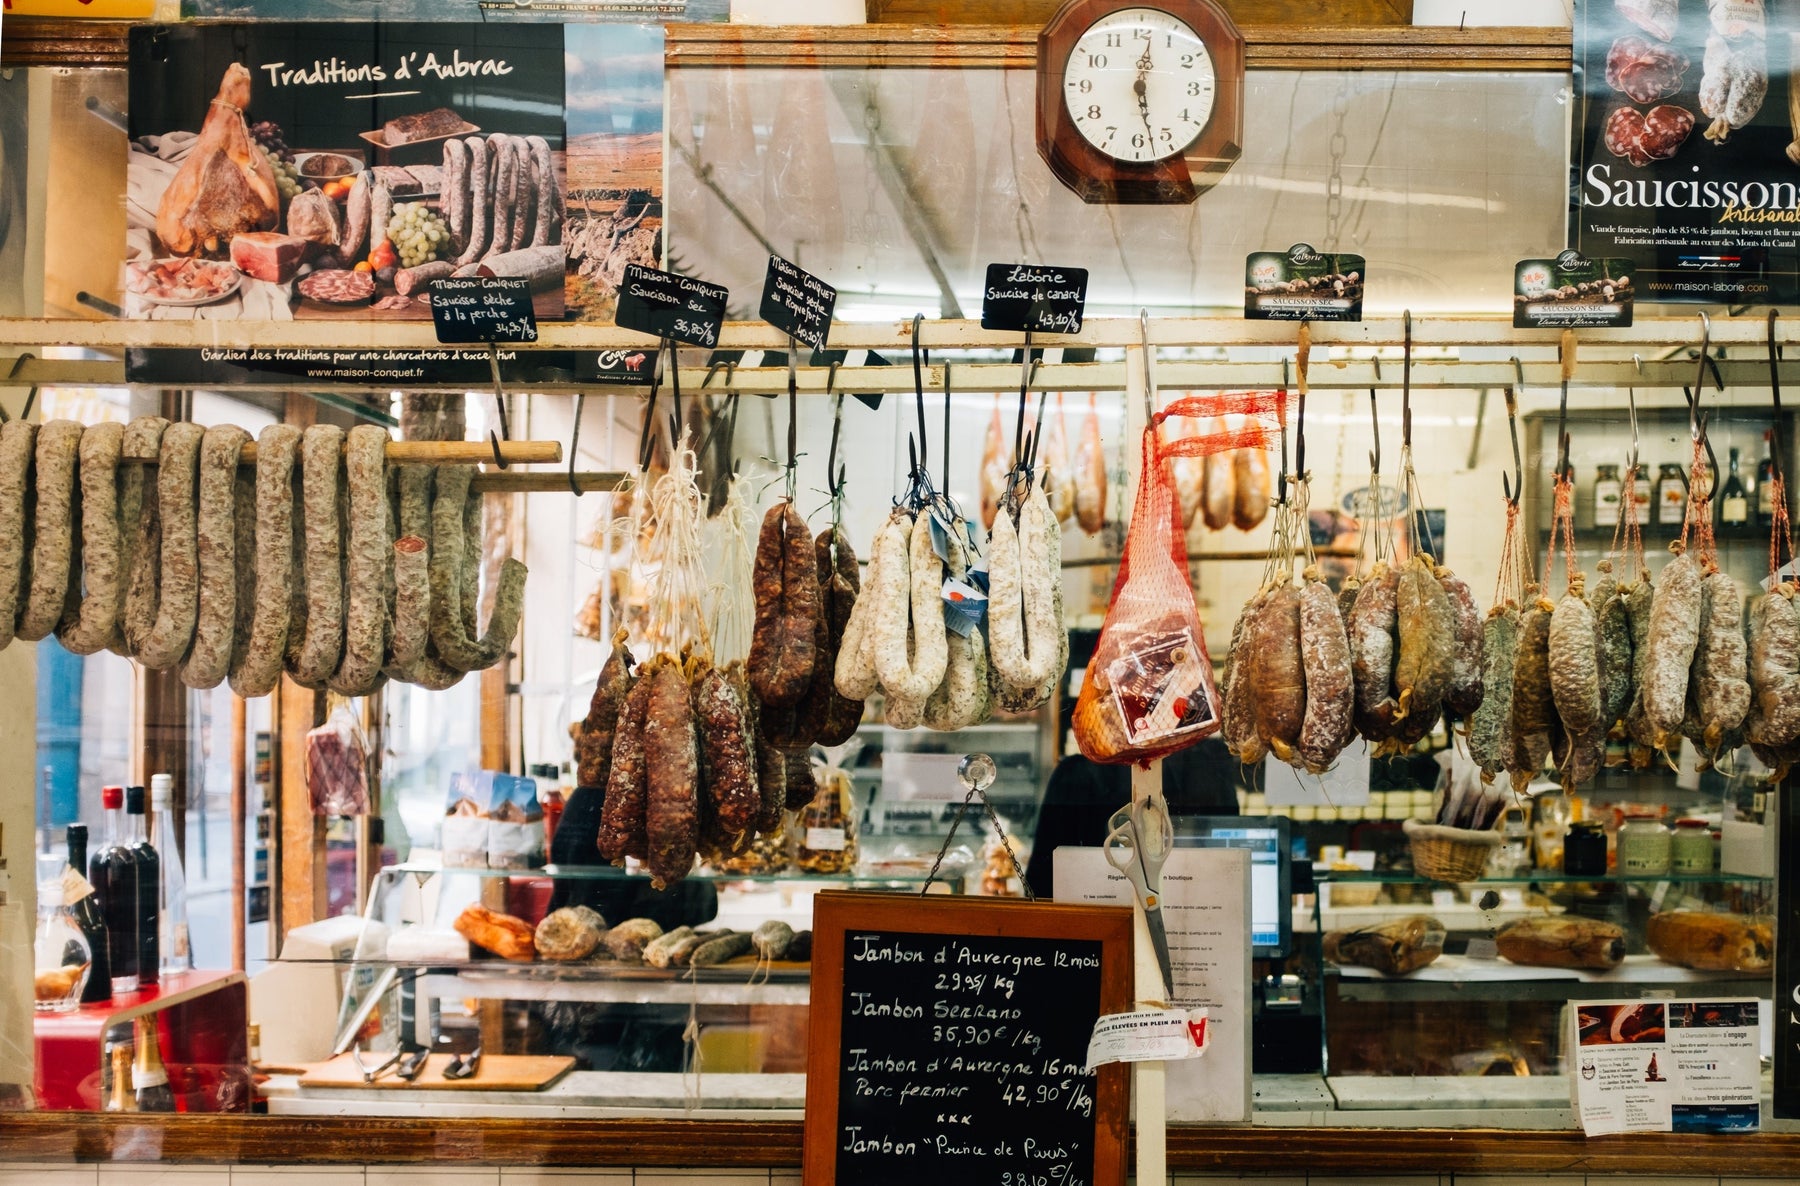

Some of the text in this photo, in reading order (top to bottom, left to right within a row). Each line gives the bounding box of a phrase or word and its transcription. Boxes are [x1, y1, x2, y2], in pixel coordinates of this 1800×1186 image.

[1106, 33, 1121, 47] 11
[1133, 28, 1152, 40] 12
[1166, 35, 1172, 48] 1
[261, 49, 513, 87] Traditions d'Aubrac
[1088, 54, 1107, 68] 10
[1181, 54, 1193, 69] 2
[1080, 79, 1092, 94] 9
[1187, 81, 1200, 96] 3
[1088, 105, 1101, 119] 8
[1177, 108, 1190, 121] 4
[1106, 126, 1117, 140] 7
[1132, 133, 1144, 148] 6
[1160, 127, 1172, 141] 5
[1590, 225, 1617, 233] Viande
[1652, 227, 1668, 237] plus
[1669, 226, 1679, 234] de
[1680, 226, 1690, 234] 85
[1700, 226, 1710, 235] de
[1710, 227, 1740, 237] jambon,
[1741, 228, 1765, 238] boyau
[1614, 236, 1654, 245] Fabrication
[1655, 237, 1689, 246] artisanale
[1722, 238, 1735, 246] des
[1736, 239, 1760, 247] Monts
[1760, 239, 1771, 247] du
[1772, 239, 1797, 248] Cantal
[770, 255, 798, 279] Maison
[1006, 265, 1067, 284] Laborie
[430, 280, 477, 290] Maison
[628, 265, 729, 301] Maison CONQUET
[1648, 281, 1769, 293] www.maison-laborie.com
[433, 292, 516, 307] Saucisse sèche
[629, 283, 681, 305] Saucisson
[986, 286, 1084, 303] Saucisse de canard
[771, 291, 822, 327] au Roquefort
[1273, 298, 1335, 306] SAUCISSON SEC
[1542, 304, 1586, 312] SAUCISSON
[444, 307, 509, 325] à la perche
[201, 349, 247, 361] Gardien
[250, 350, 272, 361] des
[274, 350, 331, 361] traditions
[333, 351, 356, 364] pour
[359, 352, 379, 361] une
[382, 349, 449, 361] charcuterie
[307, 368, 424, 380] www.maison-conquet.fr
[853, 936, 925, 963] Jambon
[850, 992, 924, 1018] Jambon
[848, 1049, 917, 1074] Jambon
[1042, 1058, 1060, 1076] 16
[855, 1078, 894, 1097] Porc
[1707, 1093, 1720, 1101] trois
[1721, 1093, 1753, 1102] générations
[844, 1126, 916, 1156] Jambon
[994, 1141, 1014, 1156] de
